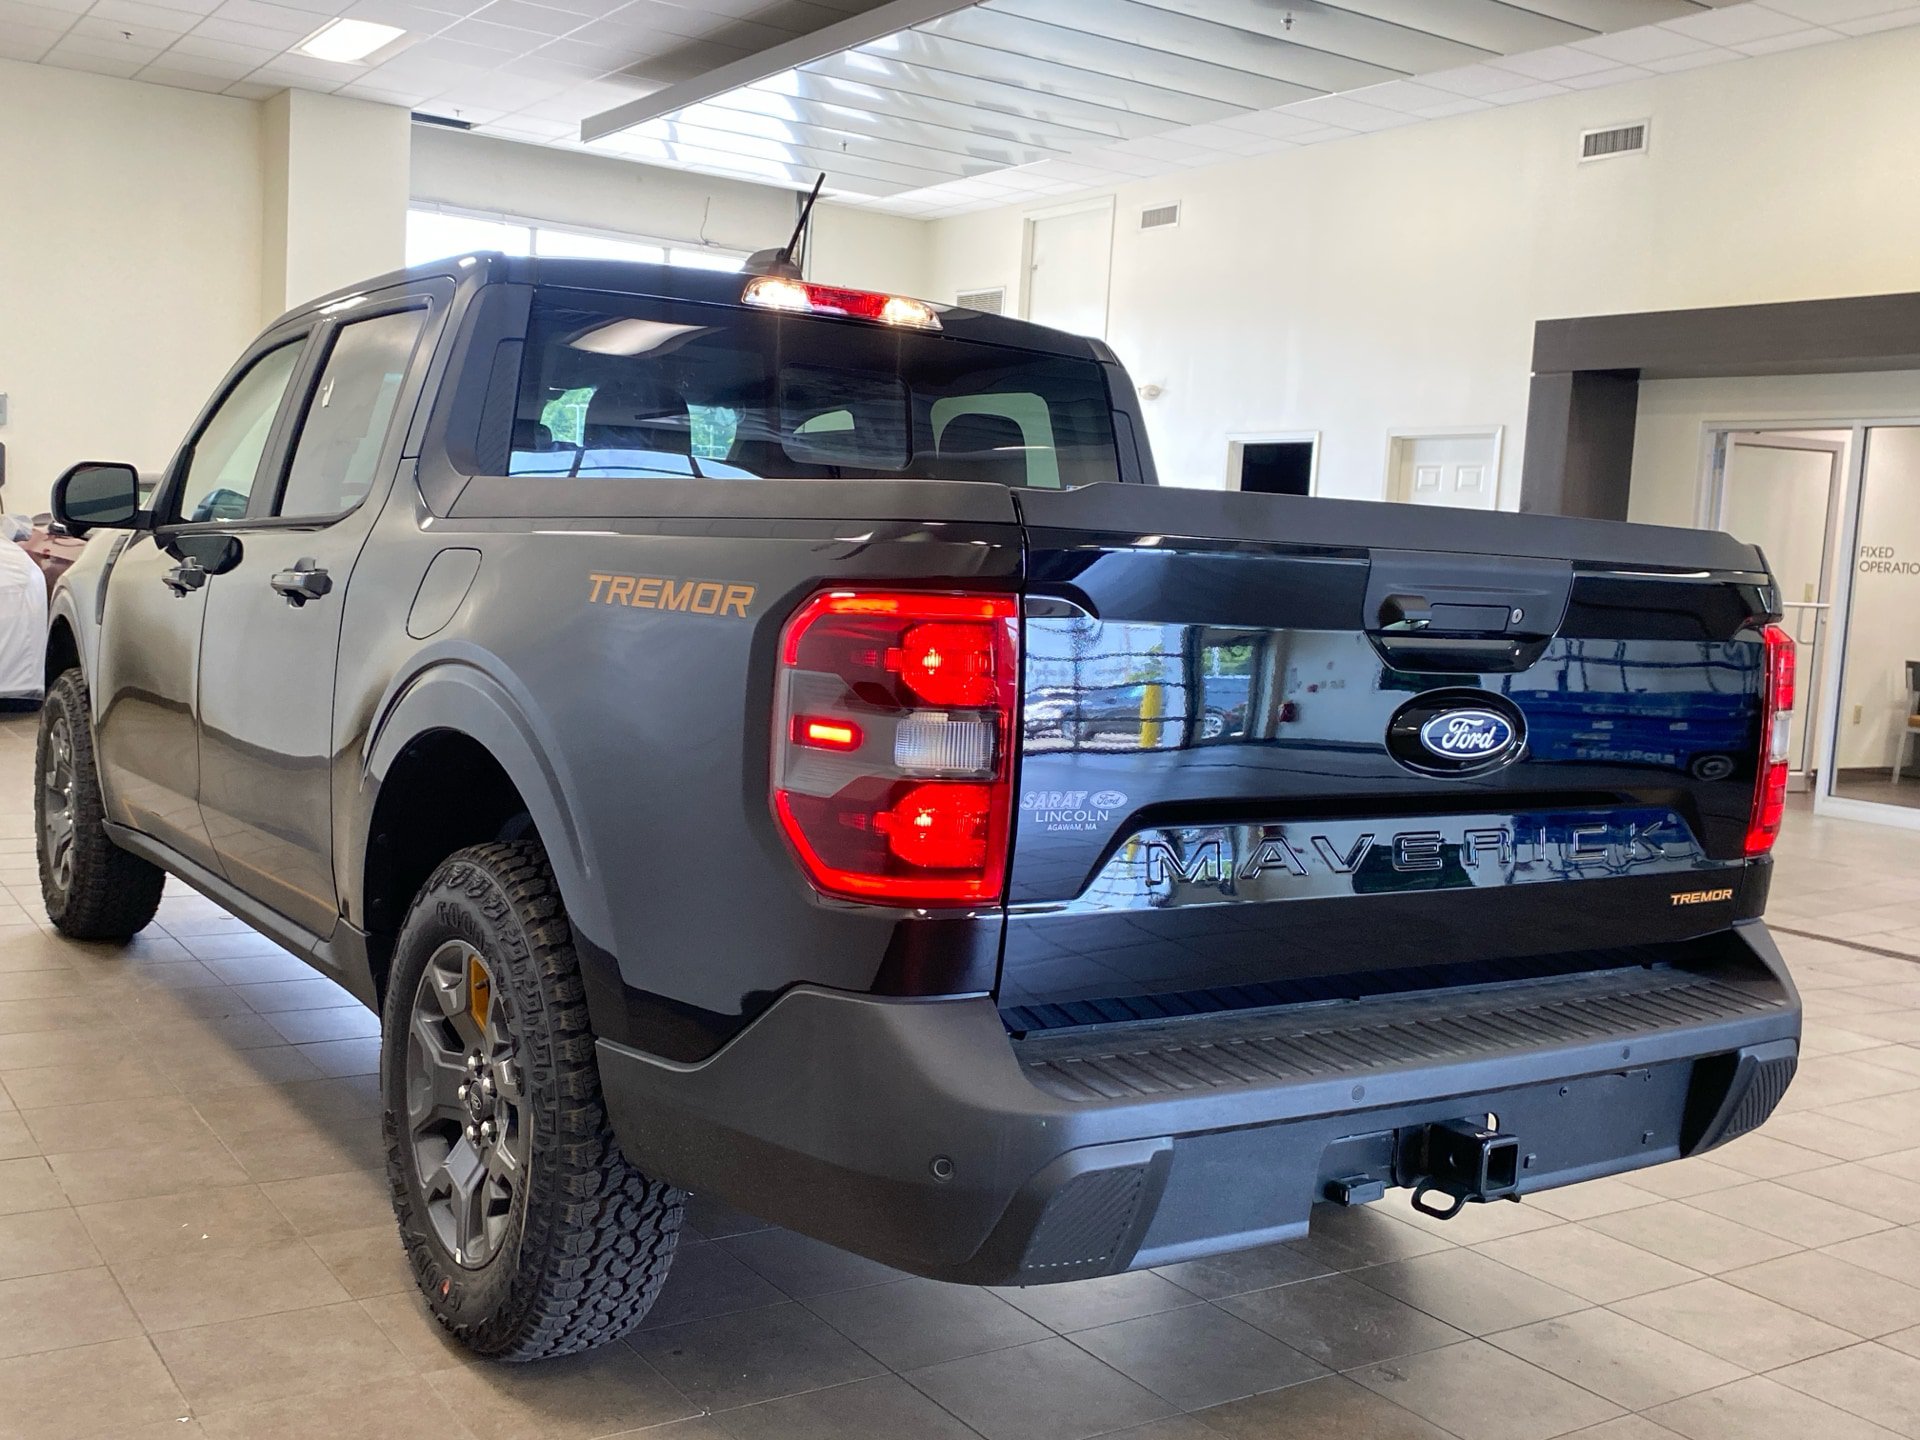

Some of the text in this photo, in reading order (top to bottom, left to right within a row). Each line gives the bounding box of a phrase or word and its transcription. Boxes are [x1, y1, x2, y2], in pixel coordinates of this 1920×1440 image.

[1860, 546, 1895, 559] FIXED
[1859, 560, 1920, 575] OPERATIO
[589, 573, 756, 618] TREMOR
[1441, 717, 1497, 750] Ford
[1020, 790, 1122, 810] SARAT Ford
[1035, 810, 1109, 822] LINCOLN
[1047, 823, 1083, 831] AGAWAM,
[1144, 820, 1665, 887] MAVERICK
[1670, 888, 1733, 906] TREMOR
